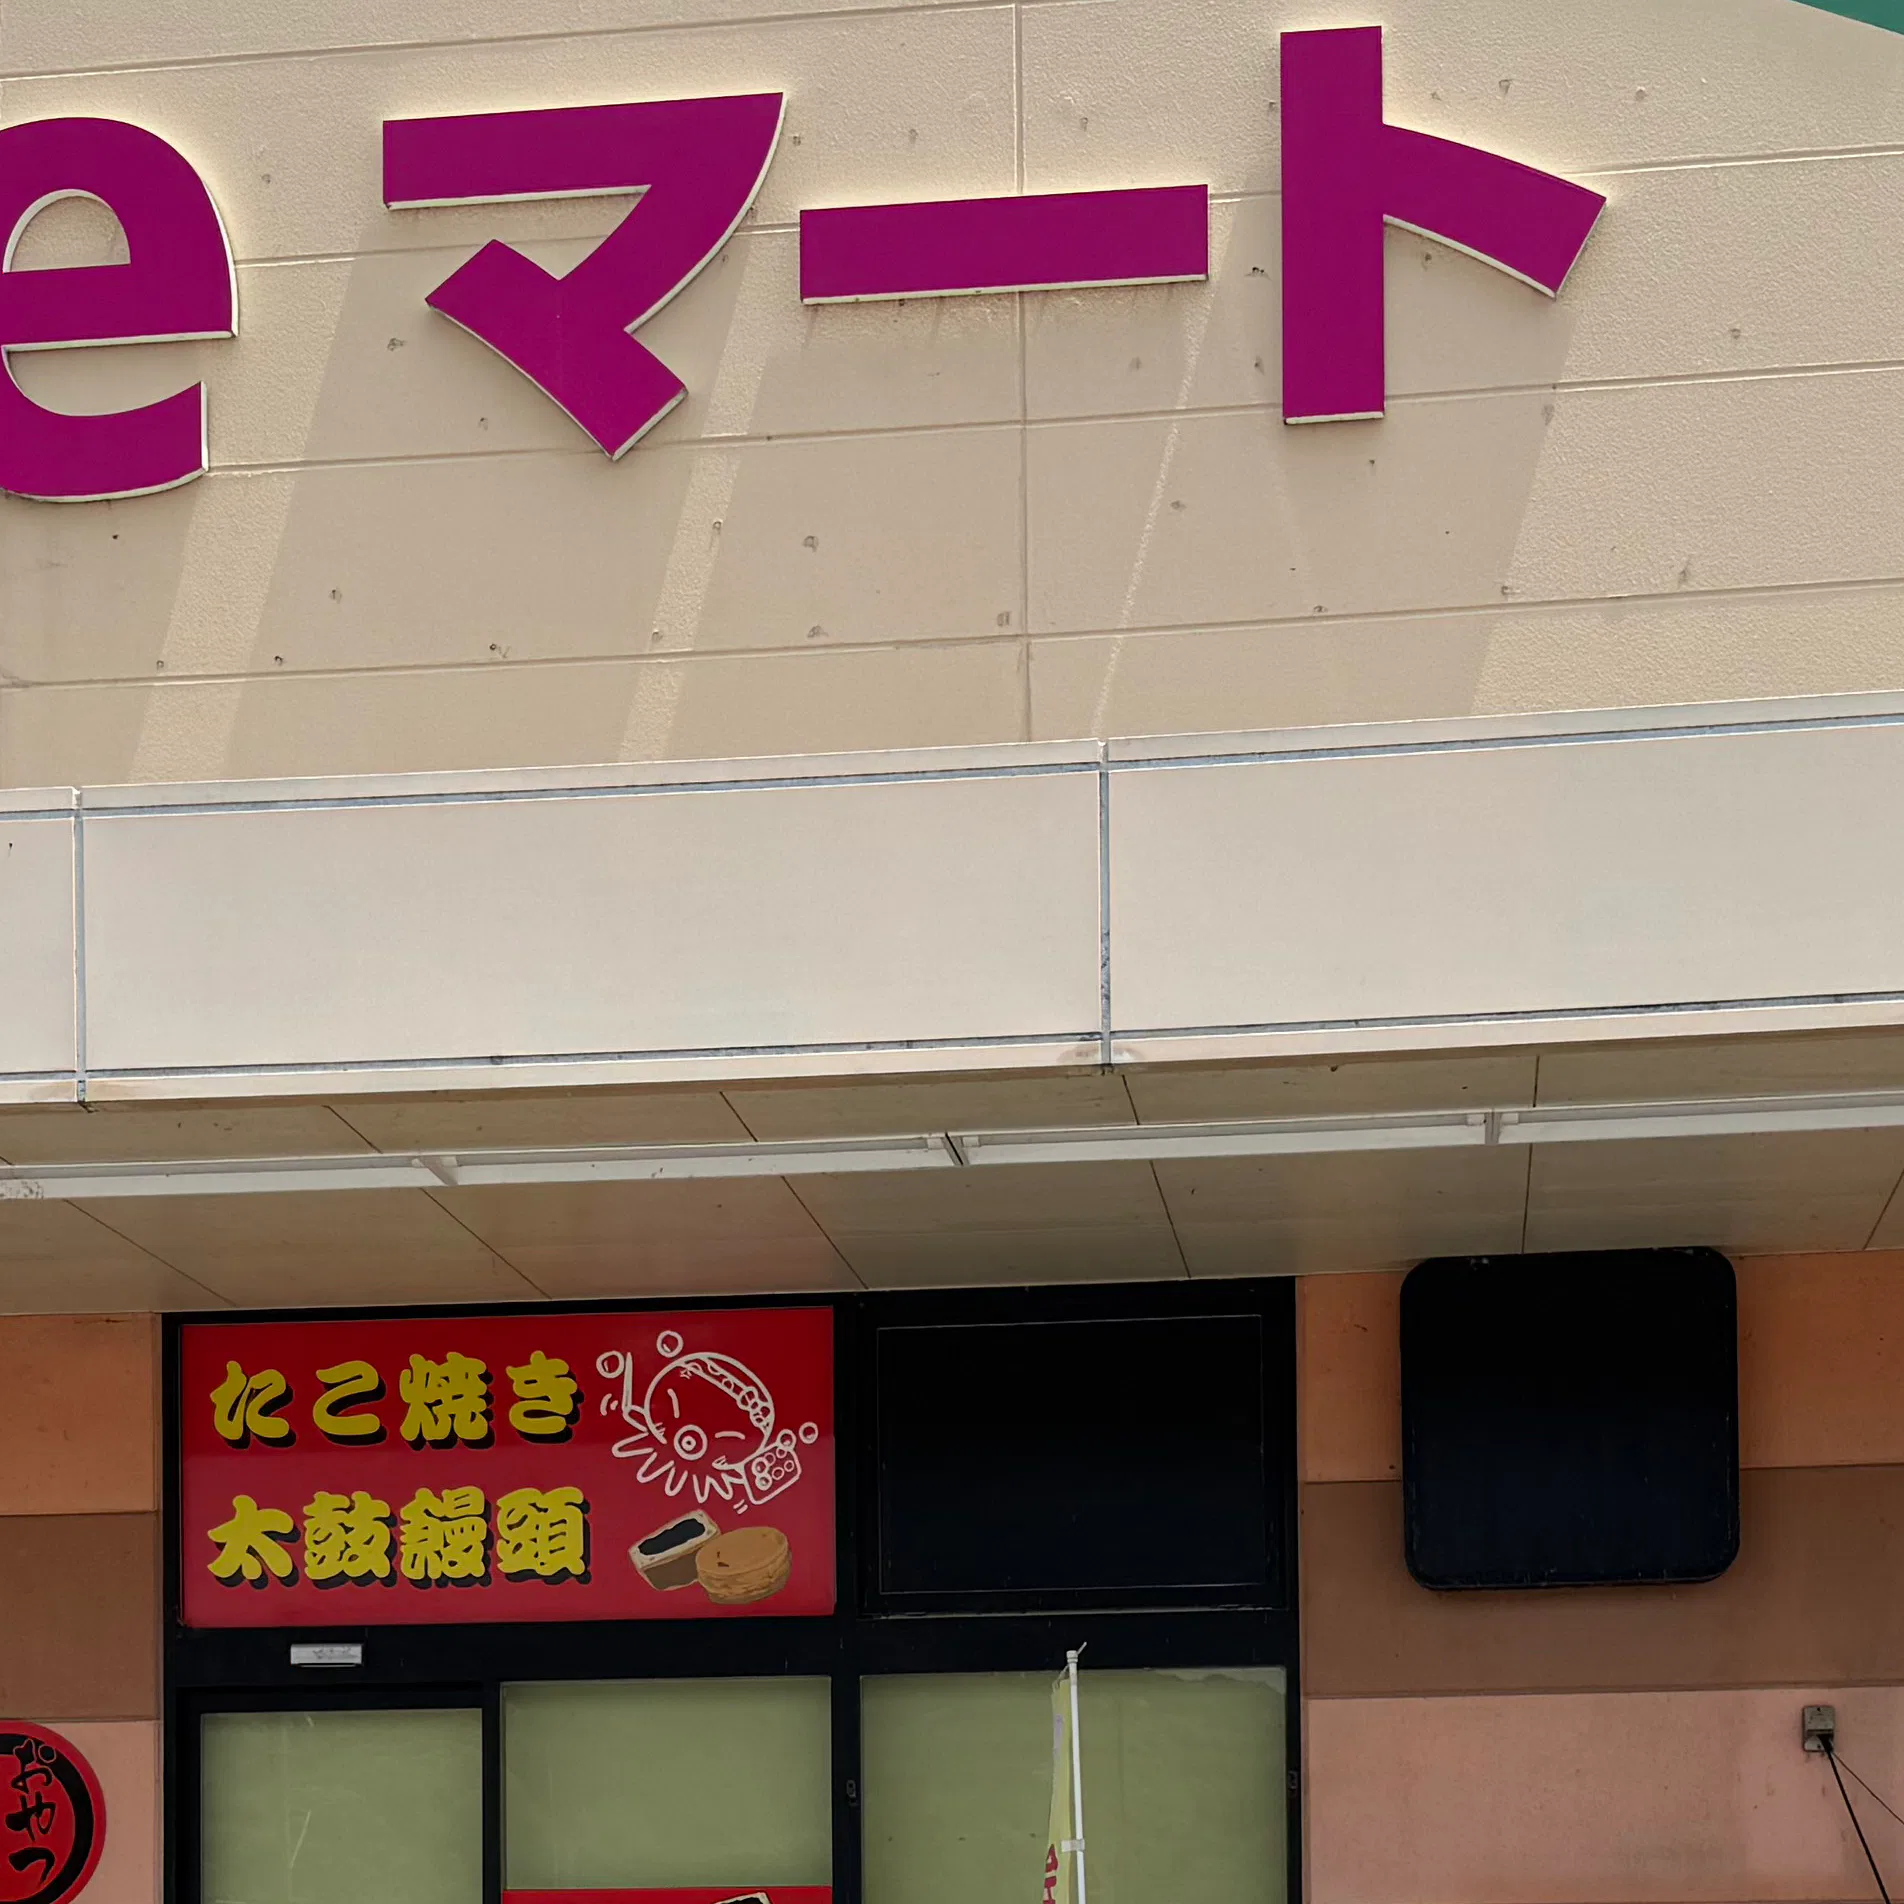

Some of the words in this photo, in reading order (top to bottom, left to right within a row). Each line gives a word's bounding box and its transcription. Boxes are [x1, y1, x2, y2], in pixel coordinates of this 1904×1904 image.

[382, 25, 1608, 455] マート
[211, 1350, 578, 1442] たこ焼き
[208, 1487, 586, 1580] 太鼓饅頭
